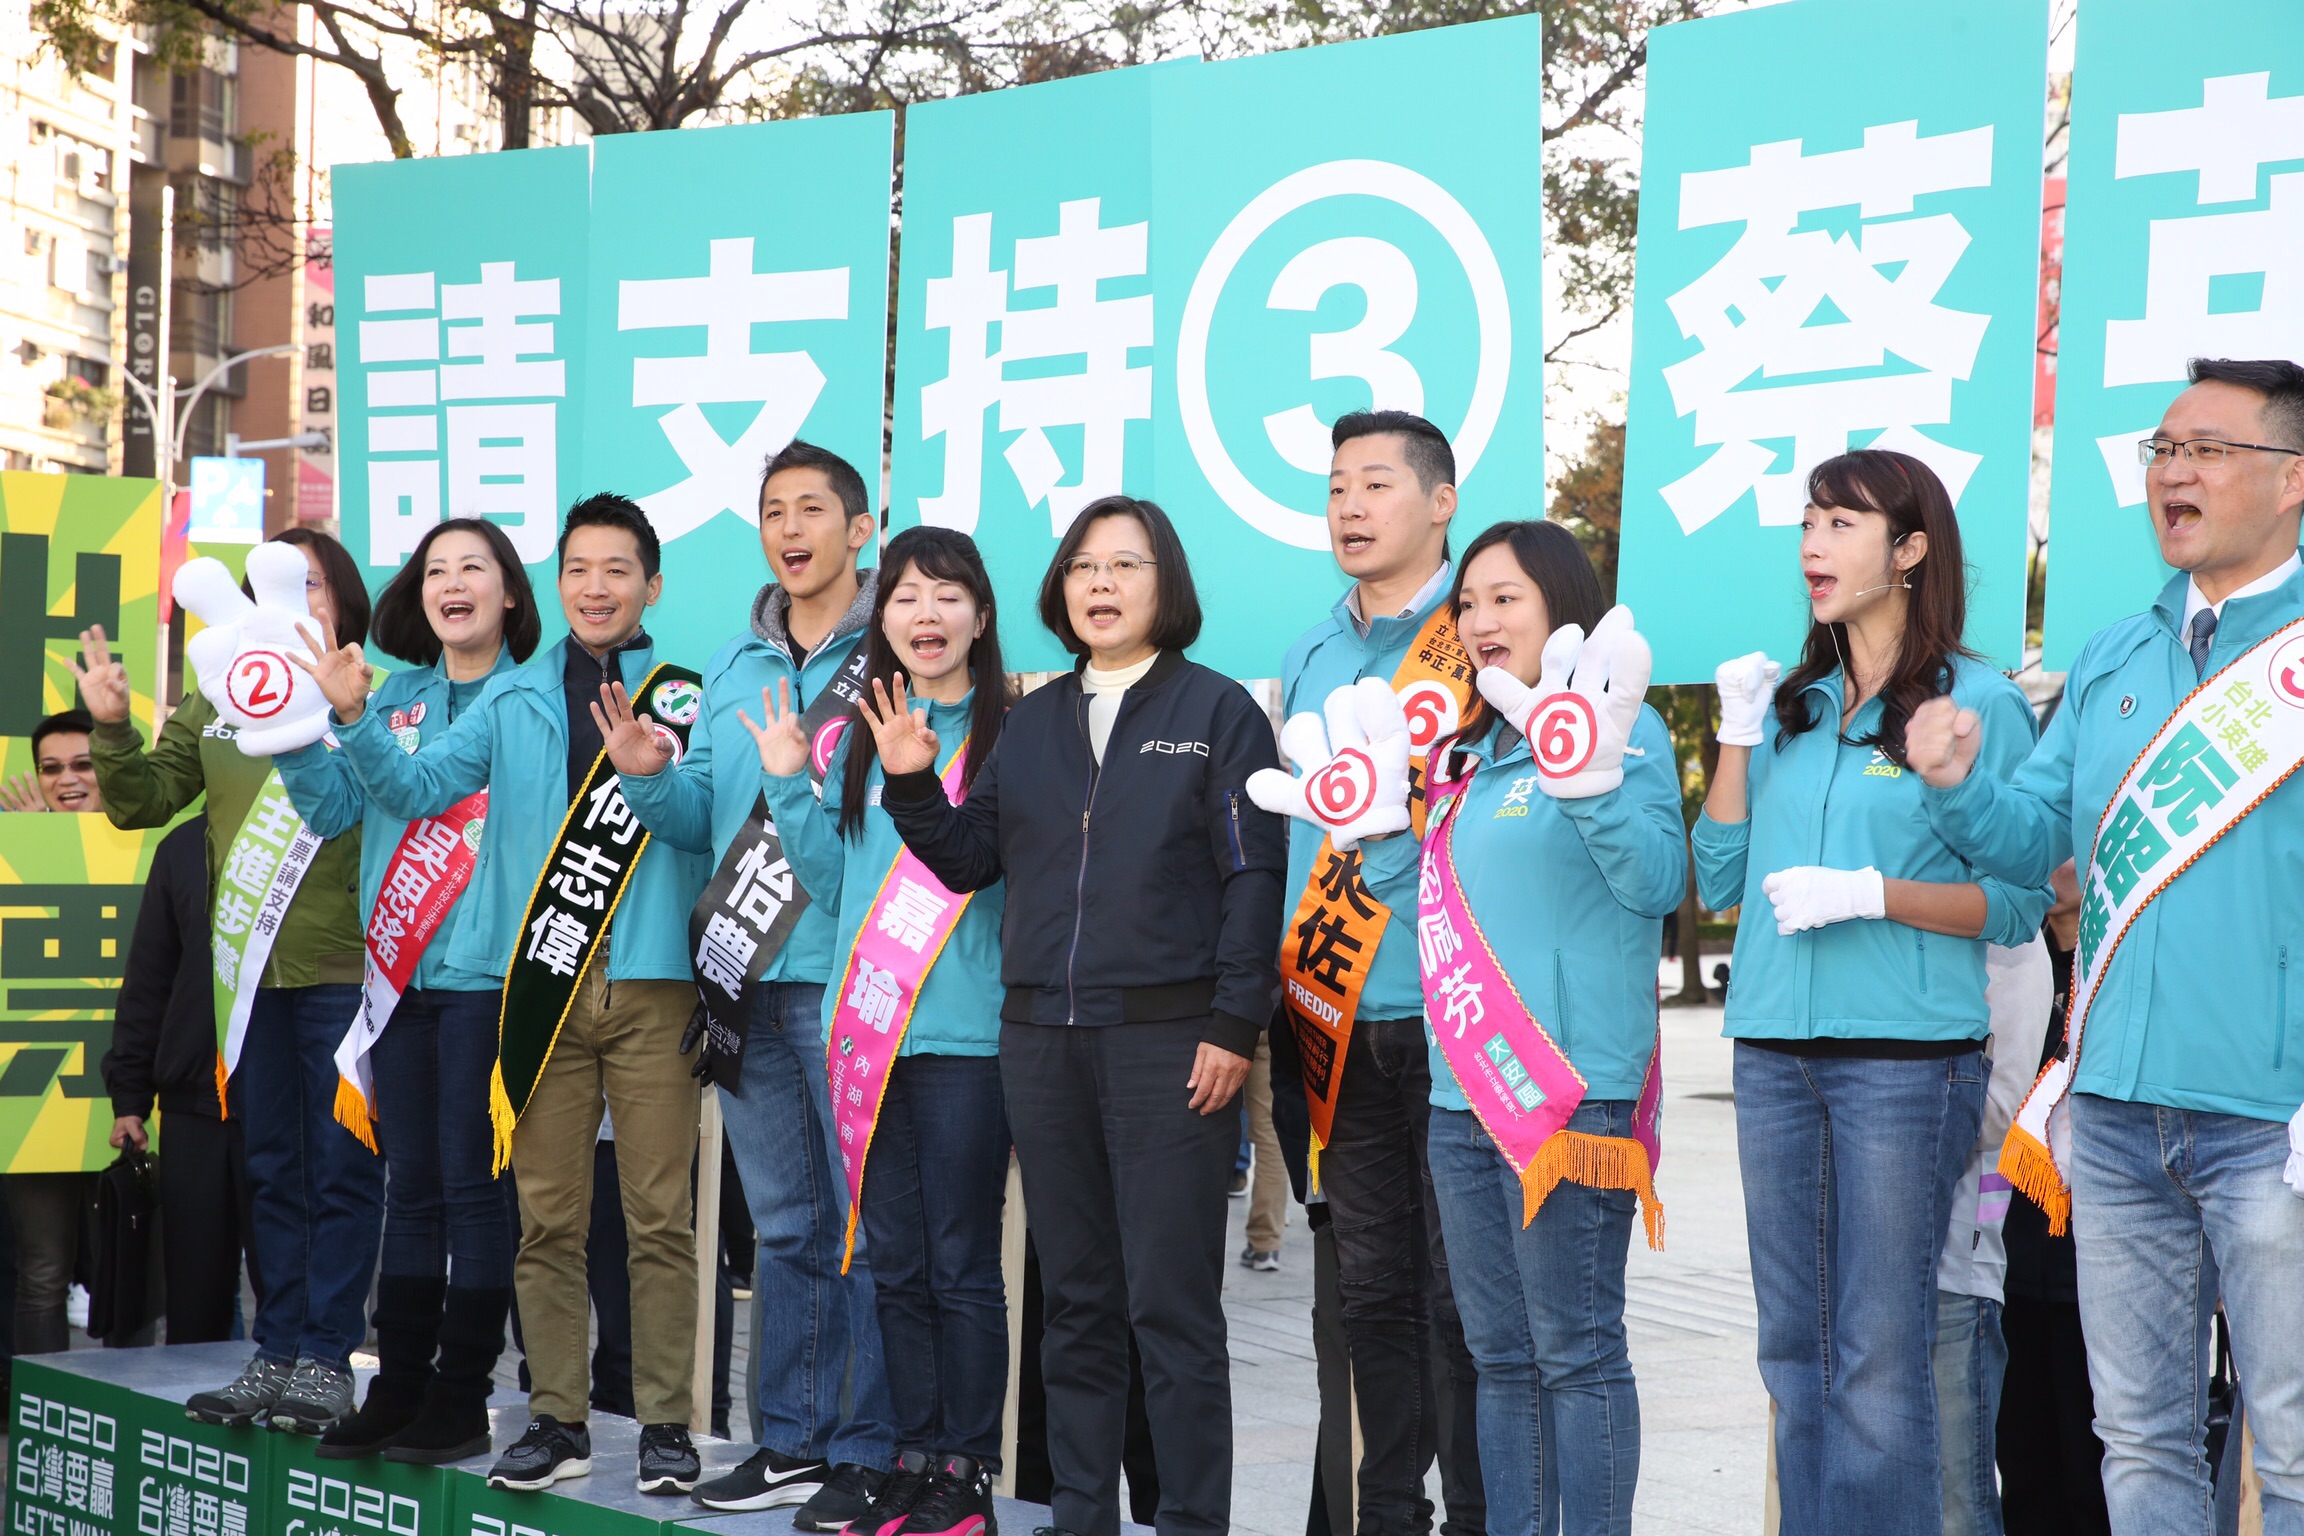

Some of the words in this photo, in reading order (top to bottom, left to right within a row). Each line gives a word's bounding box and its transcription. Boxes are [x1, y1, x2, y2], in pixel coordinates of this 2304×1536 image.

[197, 463, 229, 507] P
[241, 660, 278, 707] 2
[2223, 680, 2273, 729] 台北
[1139, 740, 1210, 758] 2020
[1402, 690, 1447, 747] 6
[1538, 709, 1577, 764] 6
[2201, 703, 2270, 775] 小英雄
[1319, 759, 1357, 812] 6
[1862, 765, 1902, 778] 2020
[1492, 805, 1529, 820] 2020
[214, 768, 300, 993] 主進步黨
[367, 816, 462, 971] 吳思瑤
[526, 774, 641, 977] 何志偉
[695, 816, 795, 1002] 怡農
[845, 876, 950, 1035] 嘉瑜
[1288, 977, 1344, 1028] FREDDY
[1488, 1037, 1544, 1110] 大安區
[18, 1392, 117, 1453] 2020
[15, 1437, 115, 1521] 台灣要贏
[140, 1428, 250, 1494] 2020
[287, 1467, 420, 1536] 2020
